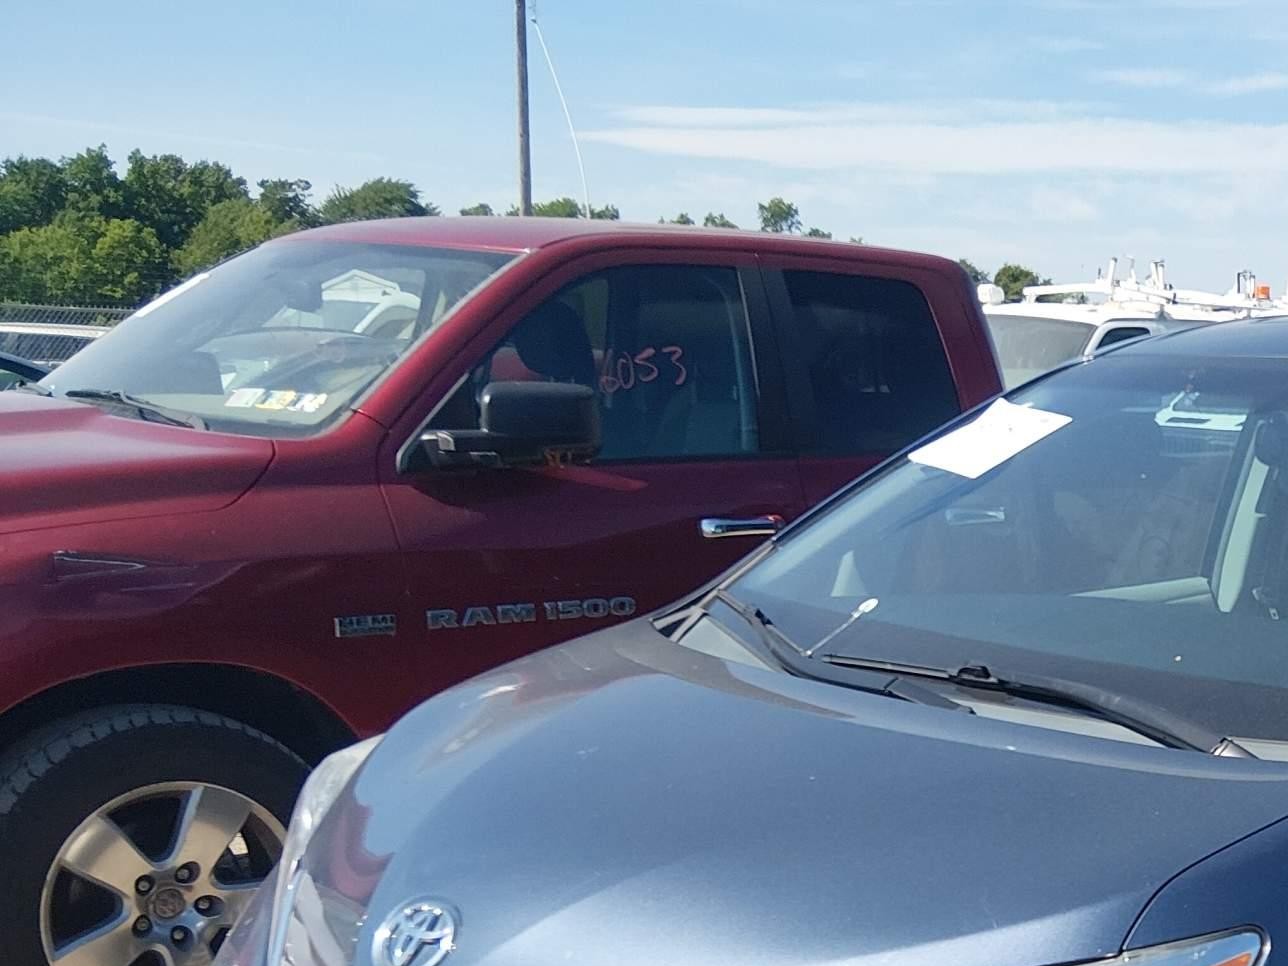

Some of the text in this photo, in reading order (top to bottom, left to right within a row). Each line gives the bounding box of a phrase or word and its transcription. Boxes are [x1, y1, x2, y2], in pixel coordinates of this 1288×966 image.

[598, 345, 688, 393] 6053
[426, 596, 637, 630] RAM 1500
